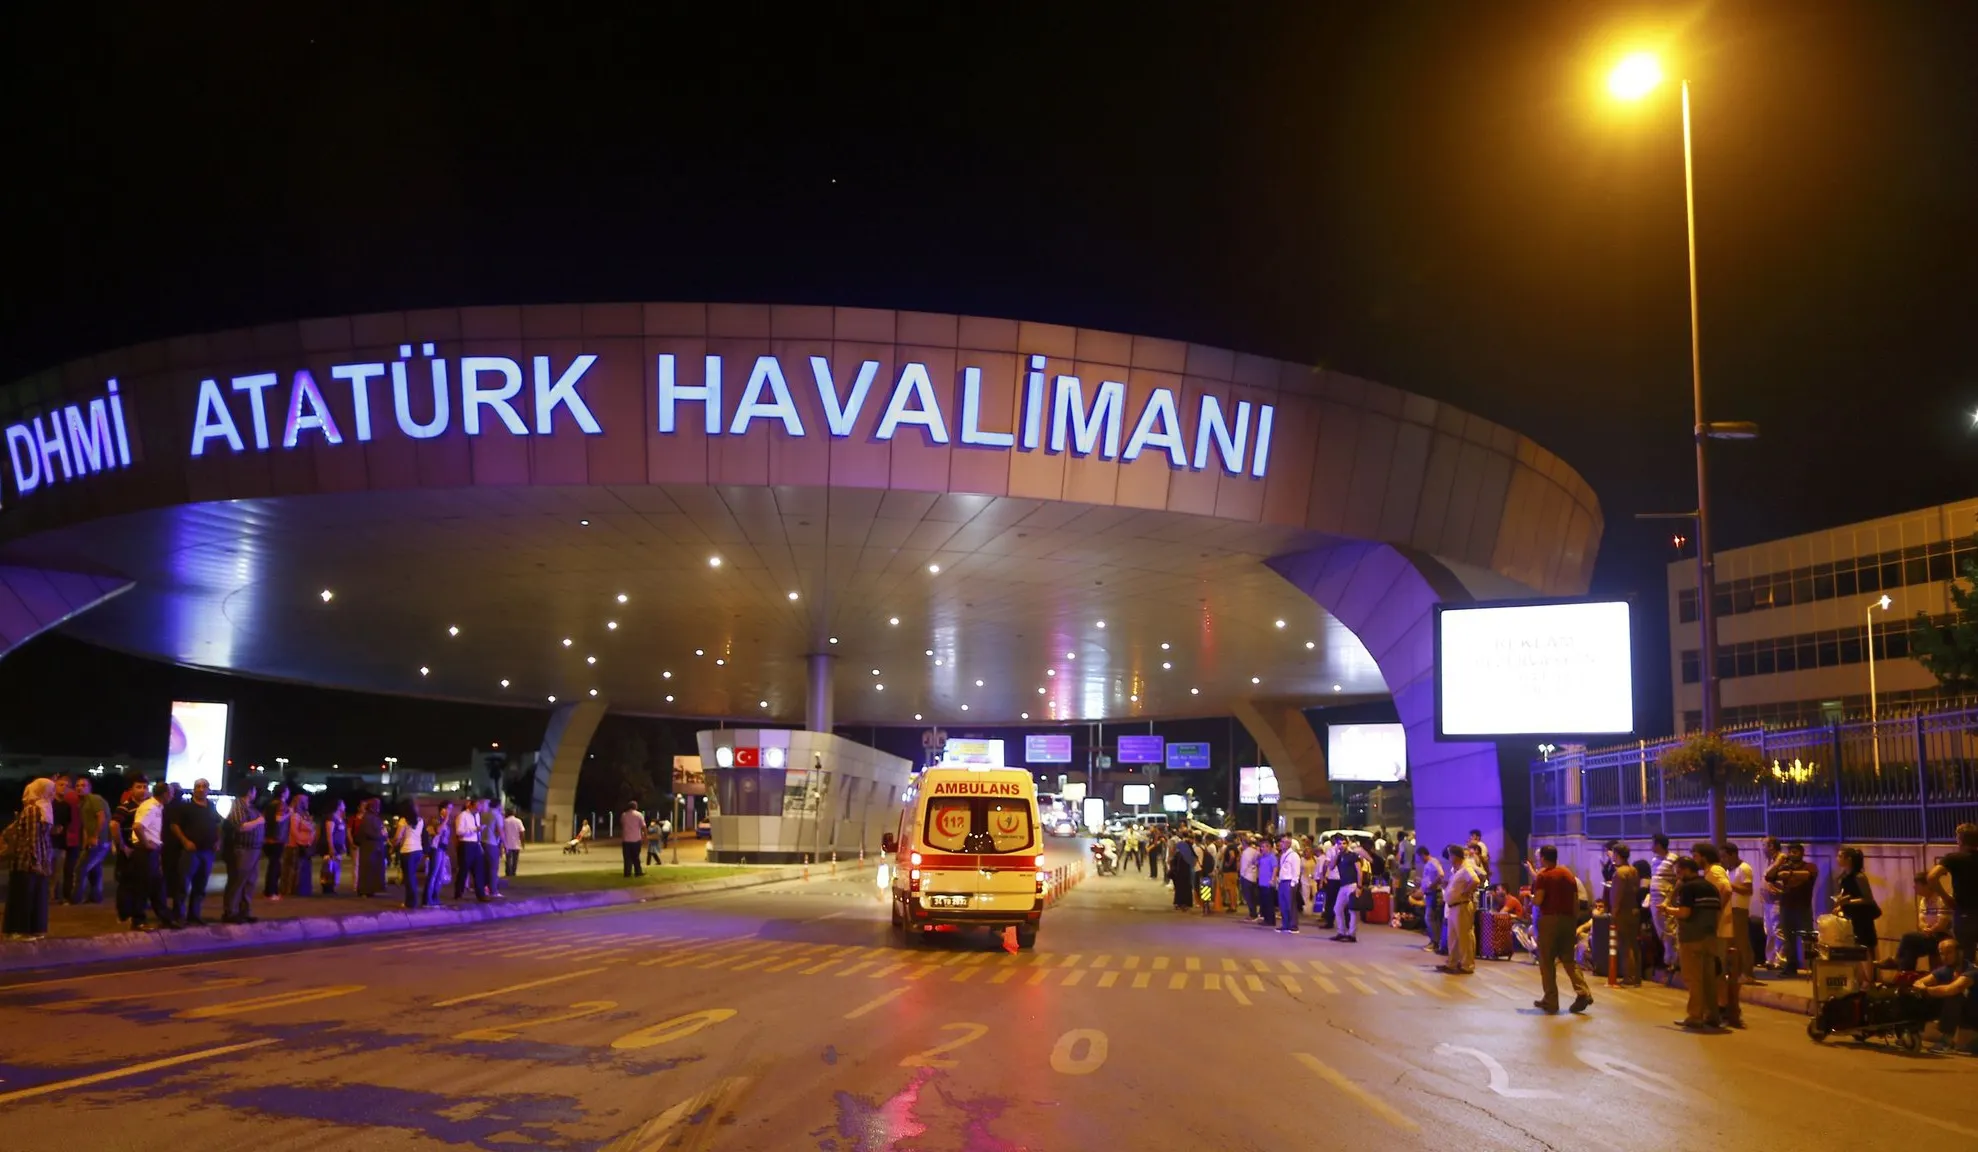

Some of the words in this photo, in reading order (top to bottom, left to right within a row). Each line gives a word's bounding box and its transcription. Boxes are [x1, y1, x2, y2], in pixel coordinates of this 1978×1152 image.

[5, 377, 132, 493] DHMİ
[190, 342, 602, 456] ATATÜRK
[656, 353, 1274, 478] HAVALİMANI
[934, 783, 1020, 795] AMBULANS
